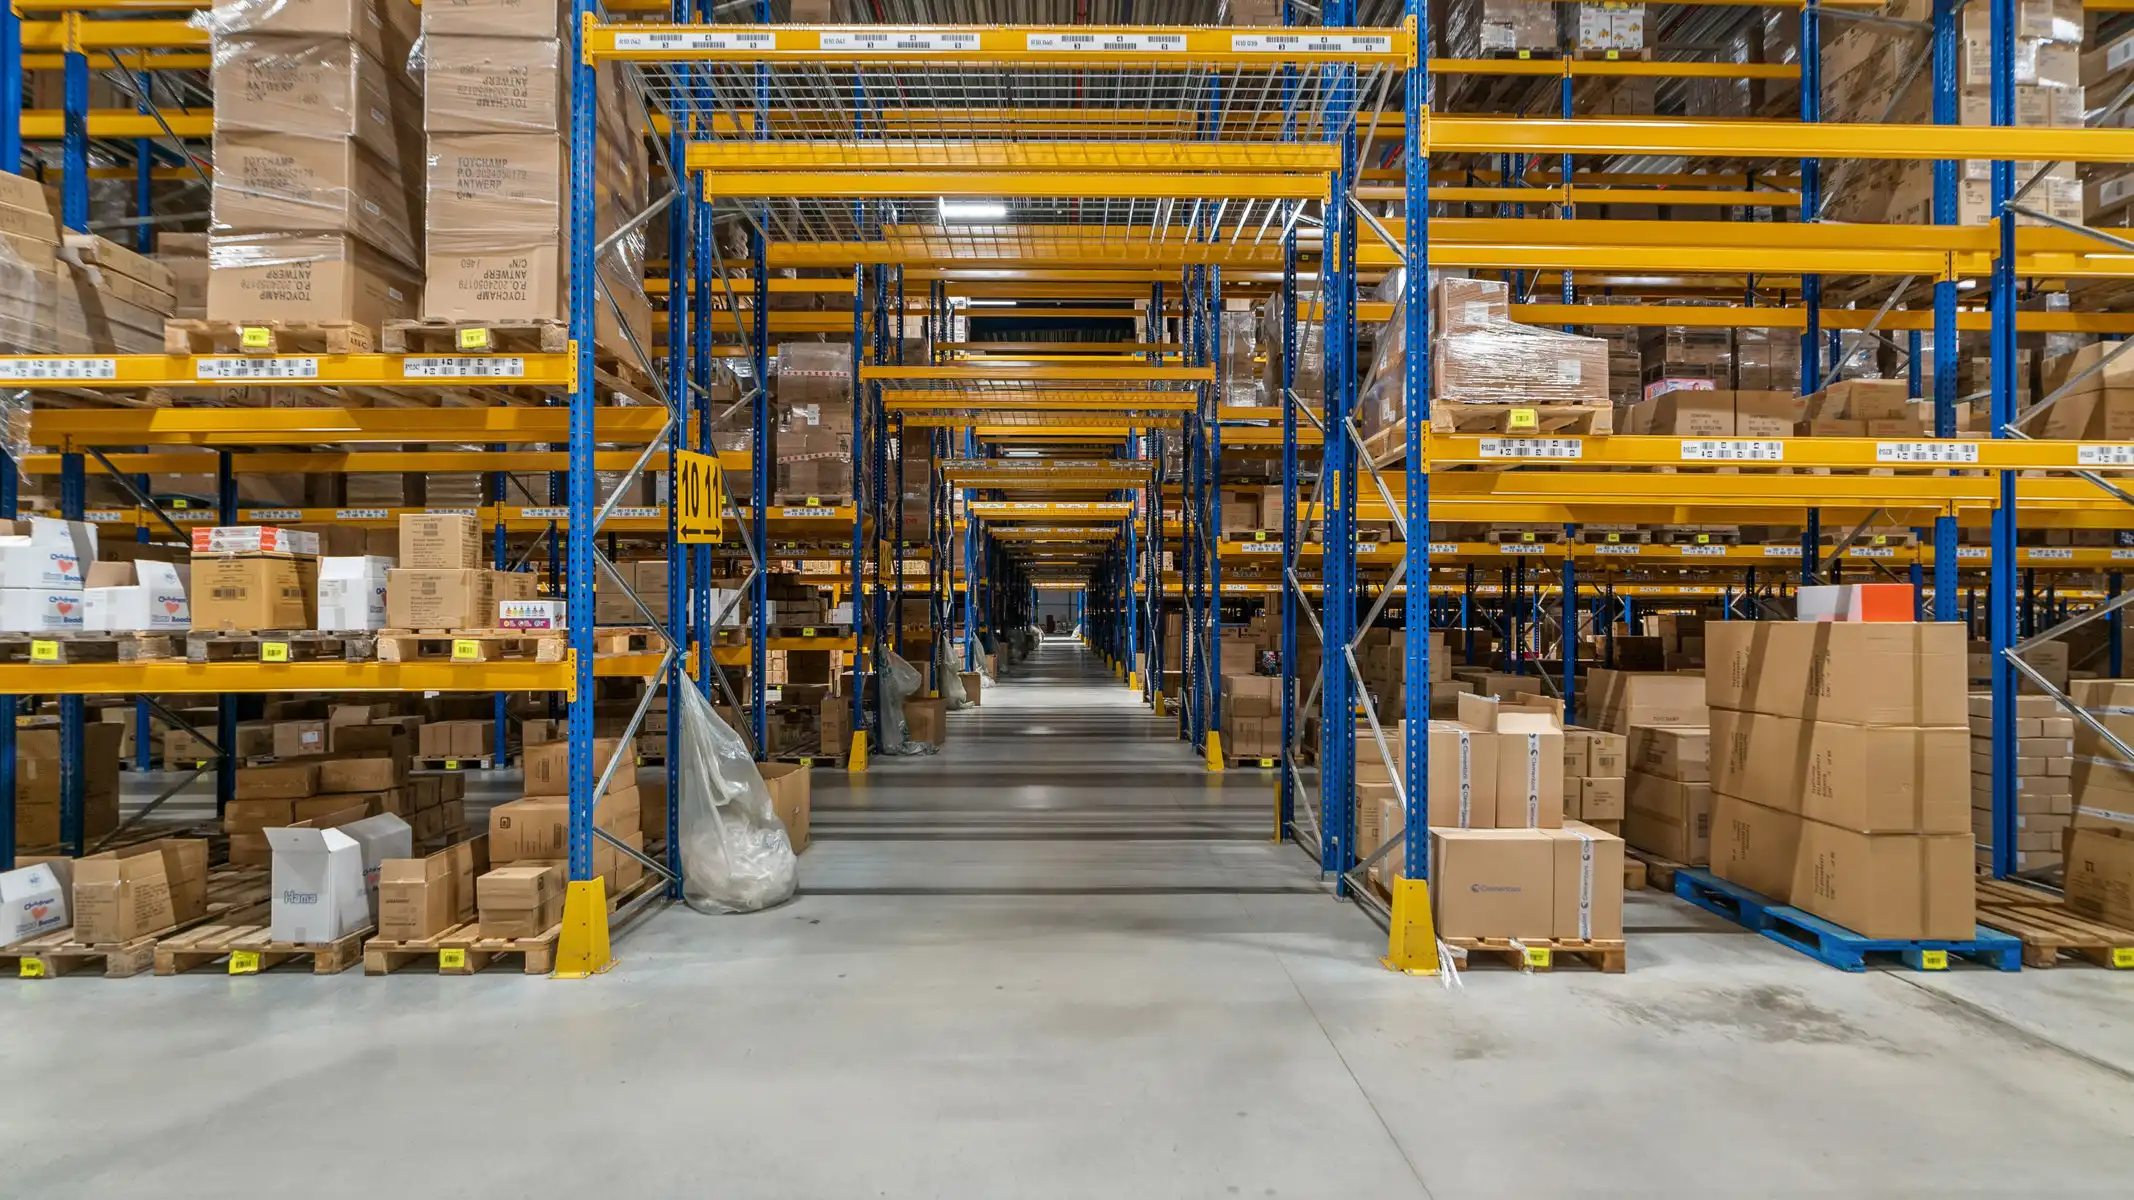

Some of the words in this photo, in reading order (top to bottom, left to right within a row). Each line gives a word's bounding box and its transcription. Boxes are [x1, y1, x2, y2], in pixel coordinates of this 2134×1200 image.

[482, 76, 528, 87] ANTWERP
[476, 98, 528, 109] TOYCHAMP
[244, 156, 295, 166] TOYCHAMP
[457, 157, 508, 168] TOYCHAMP
[457, 180, 502, 190] ANTWERP
[266, 269, 312, 279] ANTWERP
[483, 269, 527, 279] ANTWERP
[458, 279, 510, 290] 2024050179
[259, 291, 312, 301] TOYCHAMP
[476, 291, 527, 301] TOYCHAMP
[682, 460, 699, 518] 10
[705, 464, 718, 518] 11
[284, 890, 318, 904] Hama
